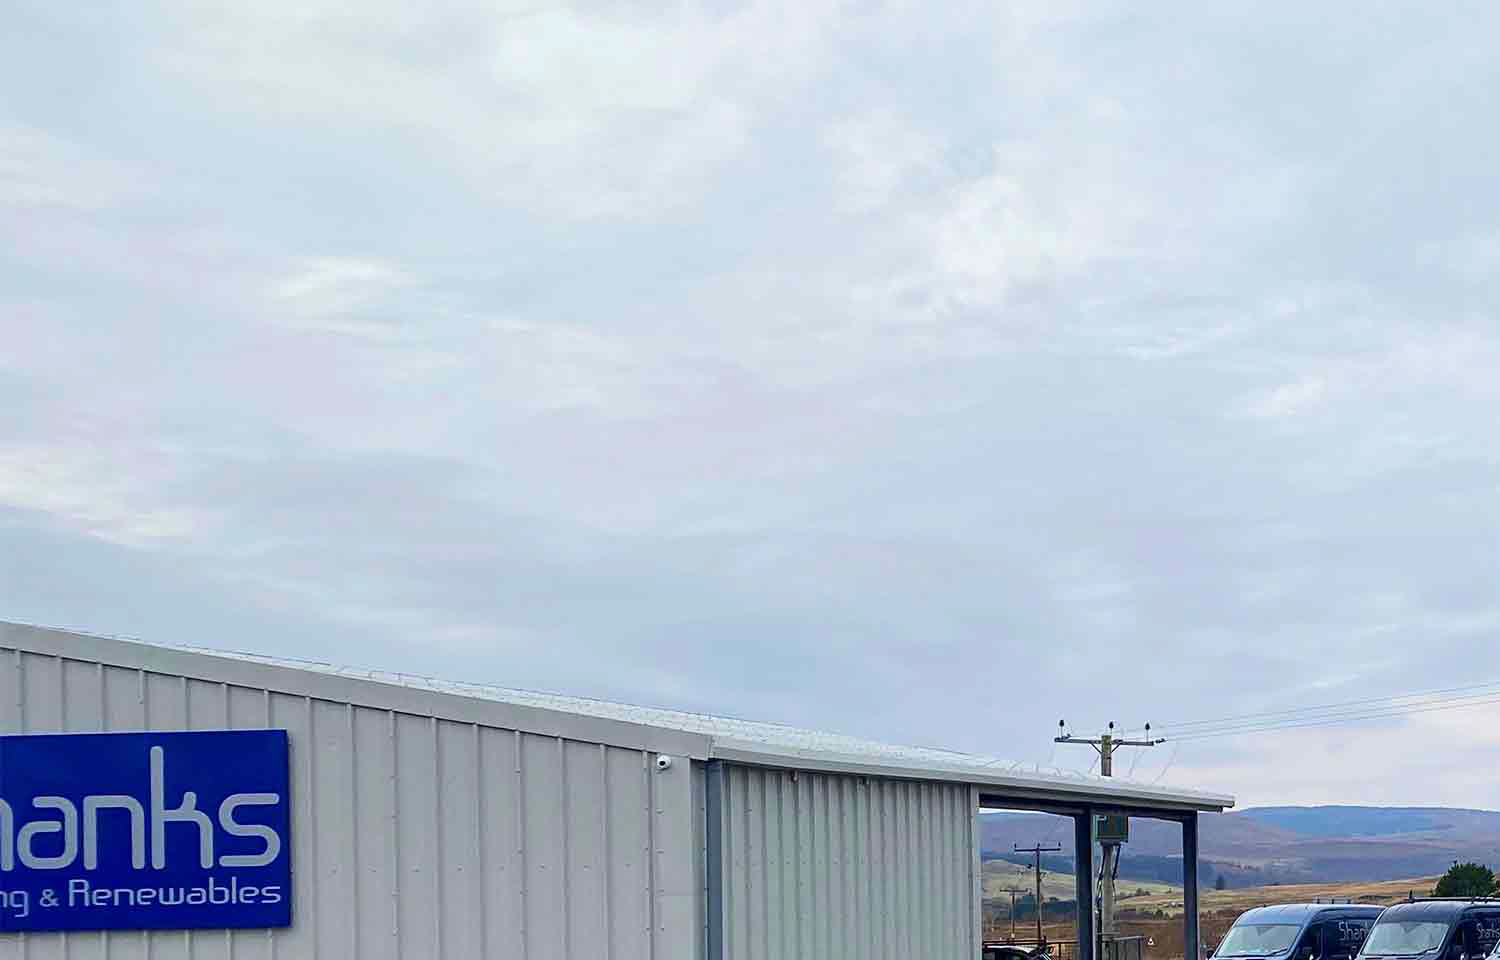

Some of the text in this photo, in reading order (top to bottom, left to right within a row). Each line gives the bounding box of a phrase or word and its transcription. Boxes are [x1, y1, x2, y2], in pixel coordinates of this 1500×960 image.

[40, 889, 59, 907] &
[68, 877, 281, 906] Renewables
[1338, 921, 1368, 941] Shan
